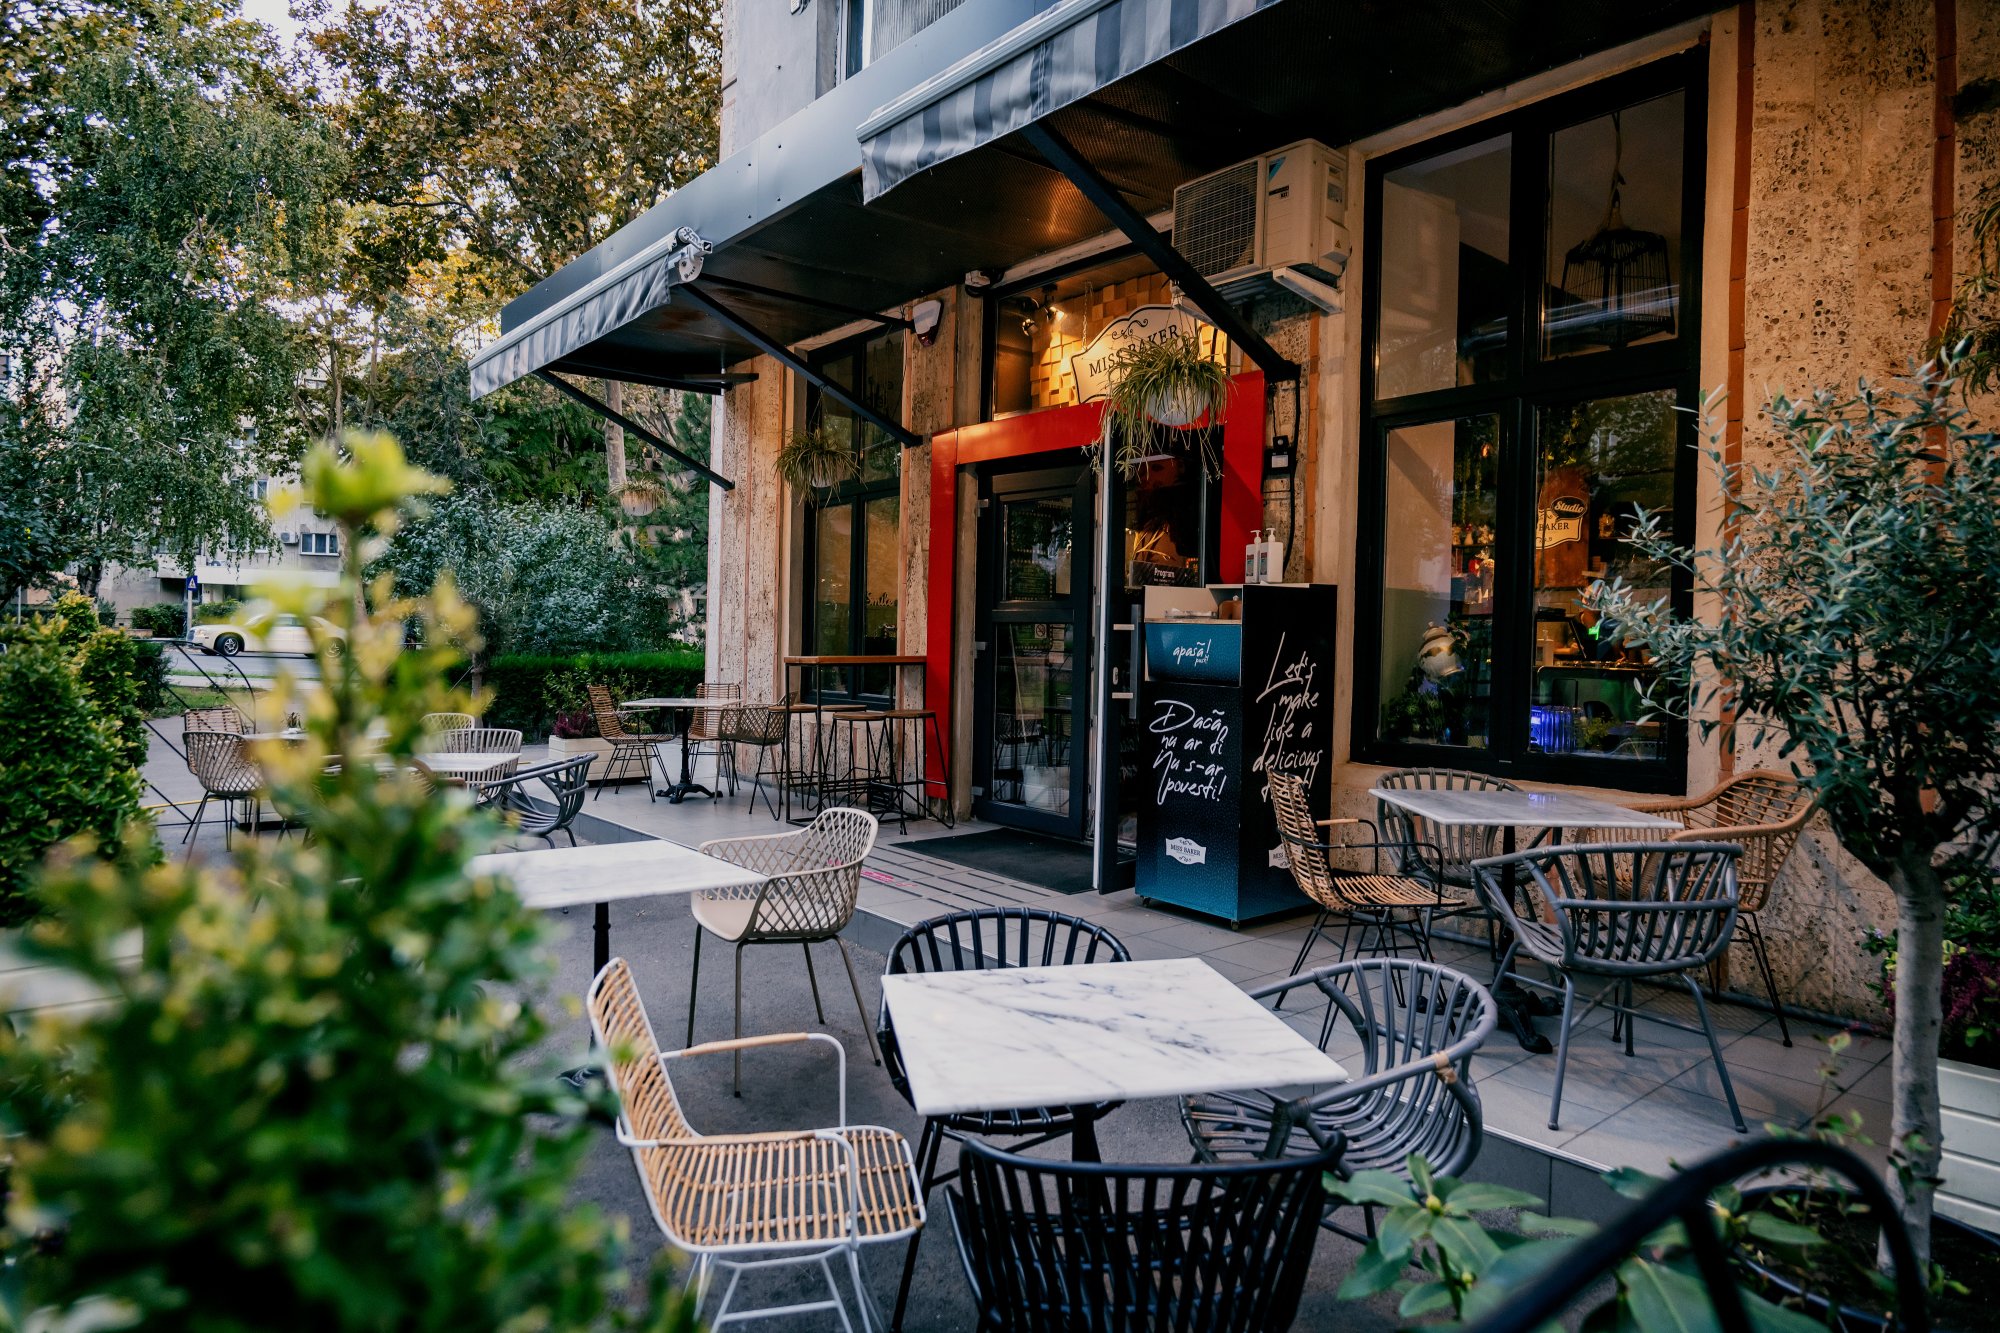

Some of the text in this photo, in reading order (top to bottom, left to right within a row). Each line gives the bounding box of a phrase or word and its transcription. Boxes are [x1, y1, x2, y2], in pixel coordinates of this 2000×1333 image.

[1089, 348, 1124, 377] MISS
[1555, 501, 1584, 513] Studio
[1154, 567, 1175, 578] Program
[1256, 631, 1316, 703] Let's
[1279, 683, 1319, 709] make
[1264, 702, 1312, 742] life a
[1161, 735, 1178, 749] nu
[1184, 738, 1203, 750] ar
[1252, 733, 1323, 772] delicious
[1185, 760, 1224, 776] s-ar
[1158, 775, 1227, 805] povesti!
[1169, 844, 1201, 857] MISS BAKER
